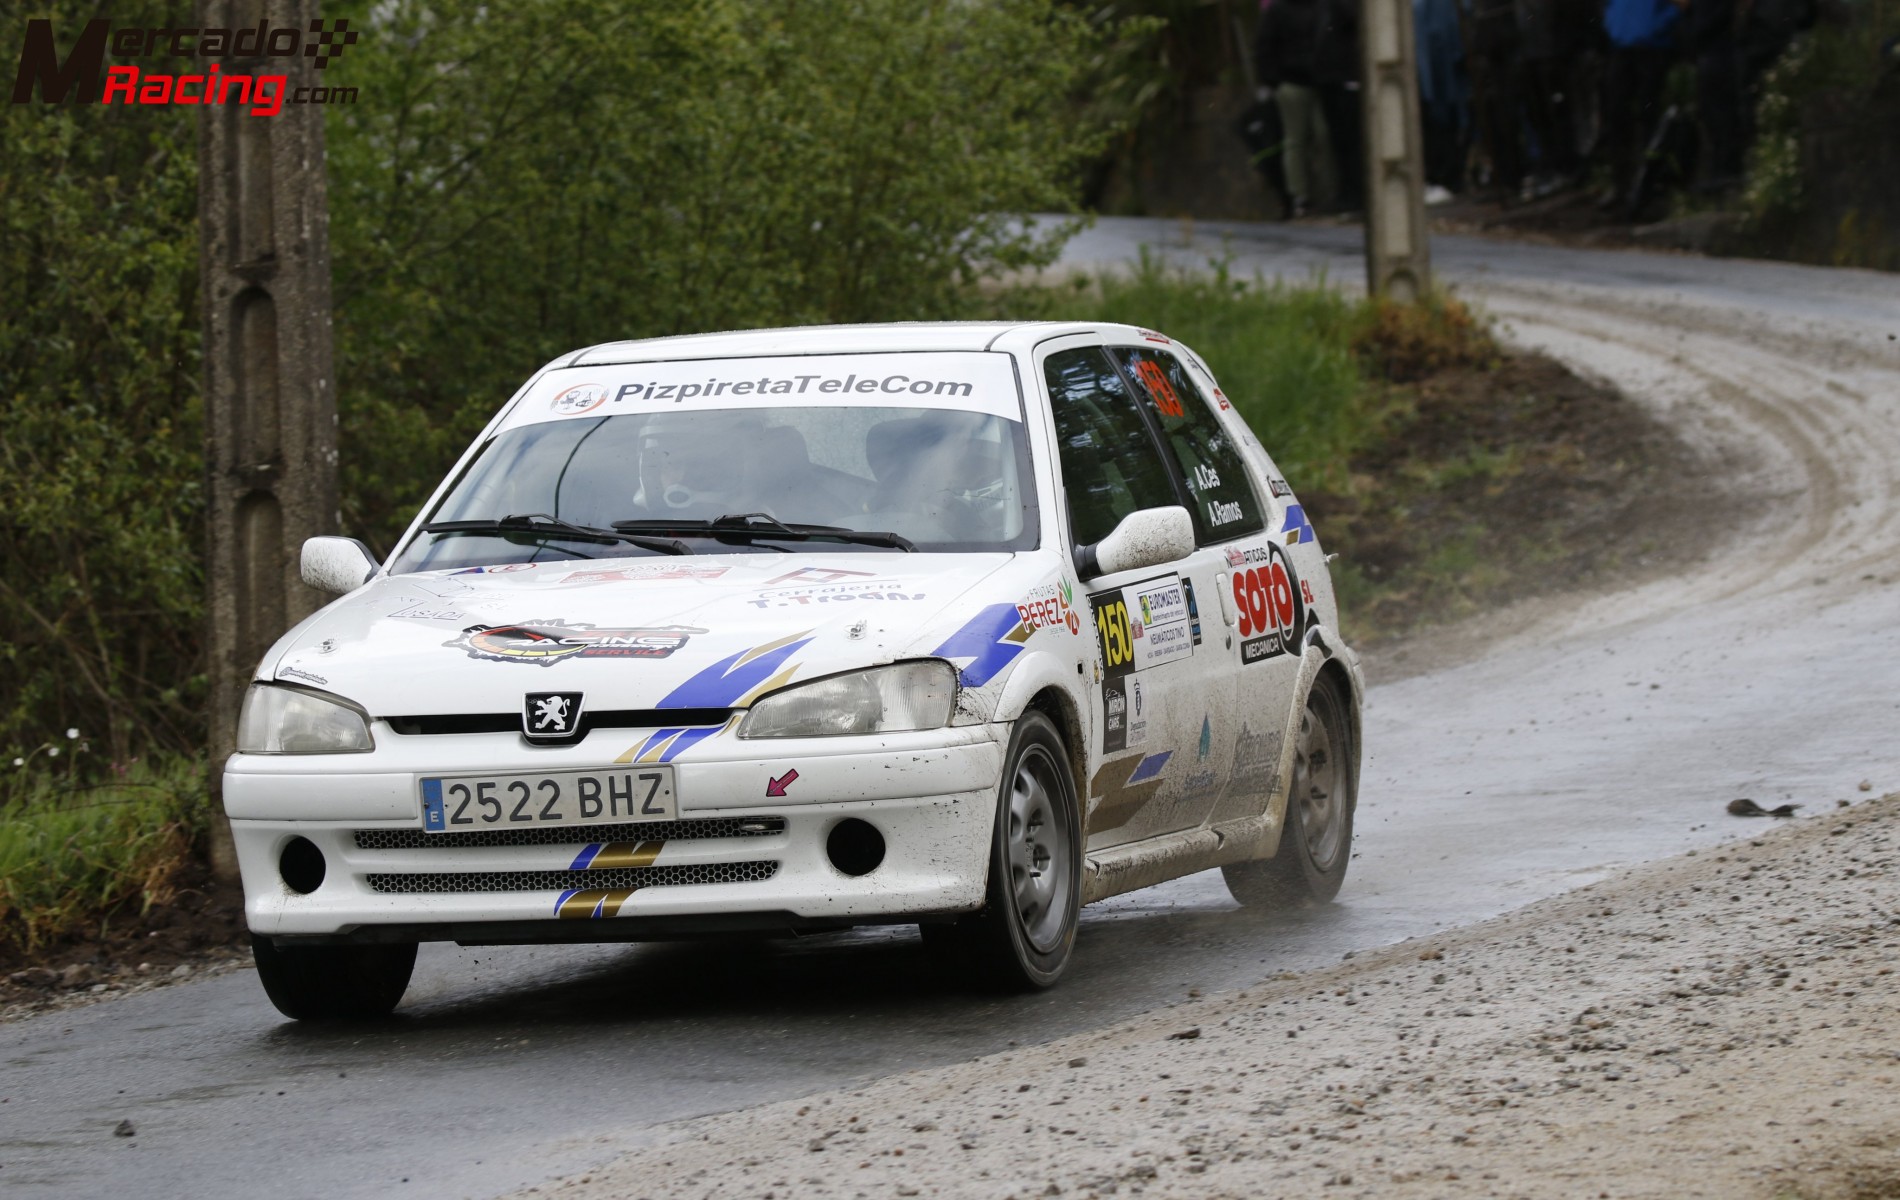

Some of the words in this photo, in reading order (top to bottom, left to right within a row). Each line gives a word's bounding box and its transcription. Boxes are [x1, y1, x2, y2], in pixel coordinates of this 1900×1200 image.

[613, 374, 974, 403] PizpiretaTeleCom
[1194, 464, 1220, 490] A.Ces
[1208, 500, 1243, 527] A.Ramos
[1225, 547, 1268, 569] NATICOS
[1148, 588, 1182, 612] EUROMASTER
[1233, 562, 1293, 638] SOTO
[1017, 597, 1063, 631] PEREZ
[505, 636, 682, 648] RACING
[1098, 600, 1133, 667] 150
[1245, 637, 1280, 659] MECANICA
[430, 812, 439, 823] E
[448, 779, 562, 825] 2522
[577, 773, 666, 819] BHZ
